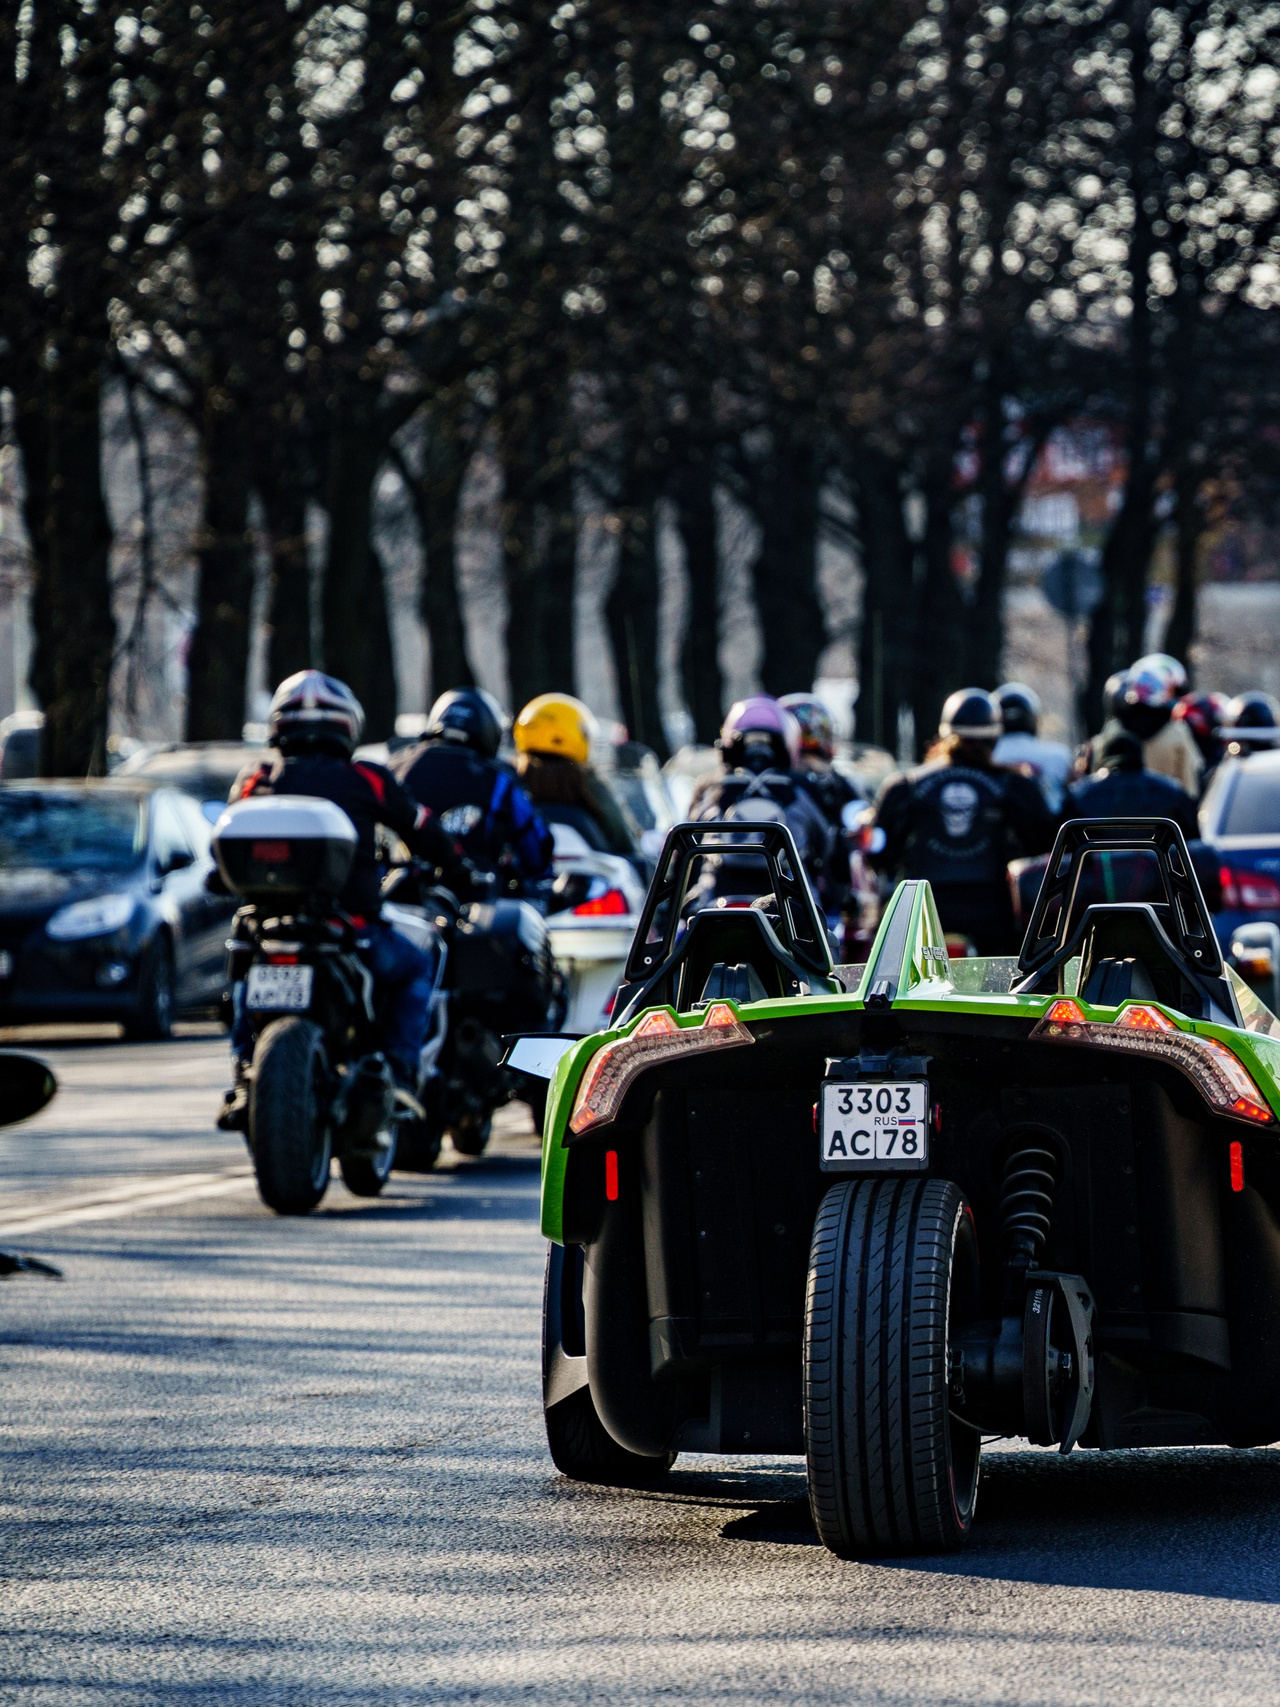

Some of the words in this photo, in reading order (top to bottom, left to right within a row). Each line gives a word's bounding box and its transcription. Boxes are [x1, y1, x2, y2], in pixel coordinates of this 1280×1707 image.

[838, 1087, 911, 1115] 3303
[874, 1116, 898, 1126] RUS
[828, 1129, 871, 1157] AC
[883, 1129, 918, 1156] 78
